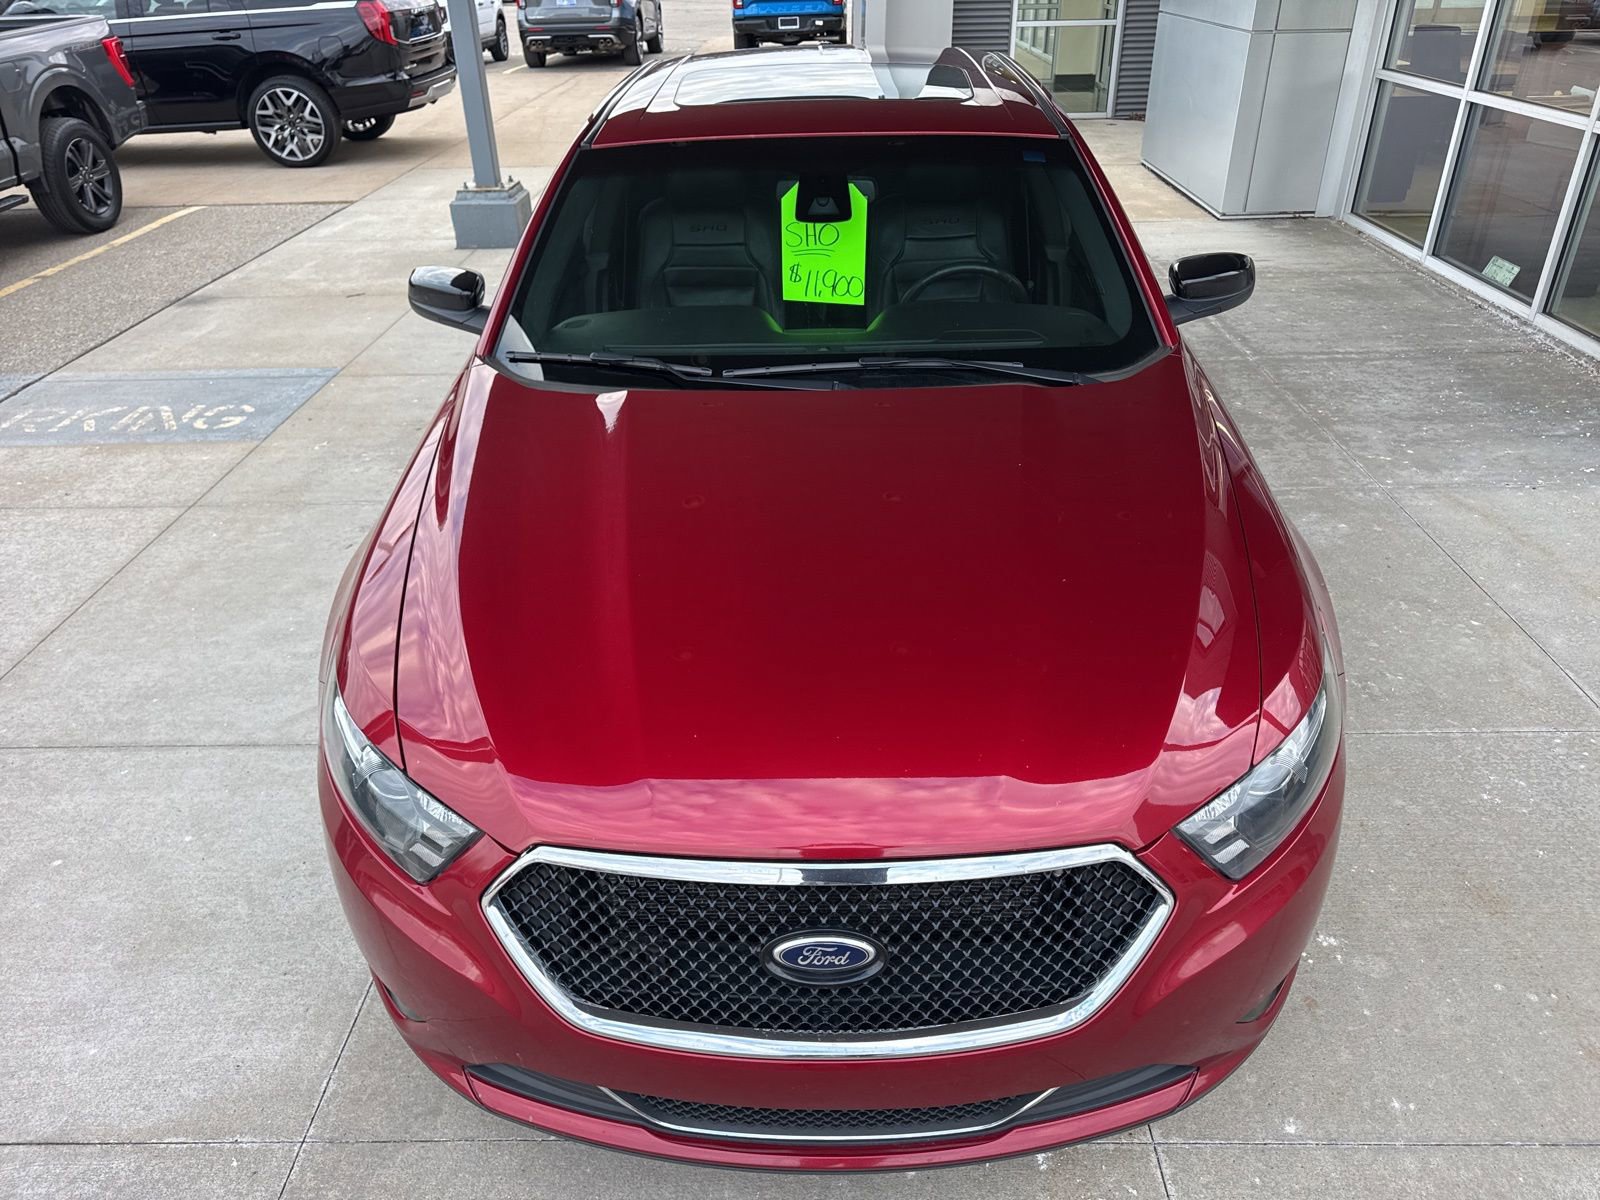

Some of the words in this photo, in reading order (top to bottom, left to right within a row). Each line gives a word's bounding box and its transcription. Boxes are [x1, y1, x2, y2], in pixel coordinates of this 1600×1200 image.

[785, 221, 840, 248] SHO
[789, 262, 864, 298] $11,900
[797, 946, 850, 966] Ford
